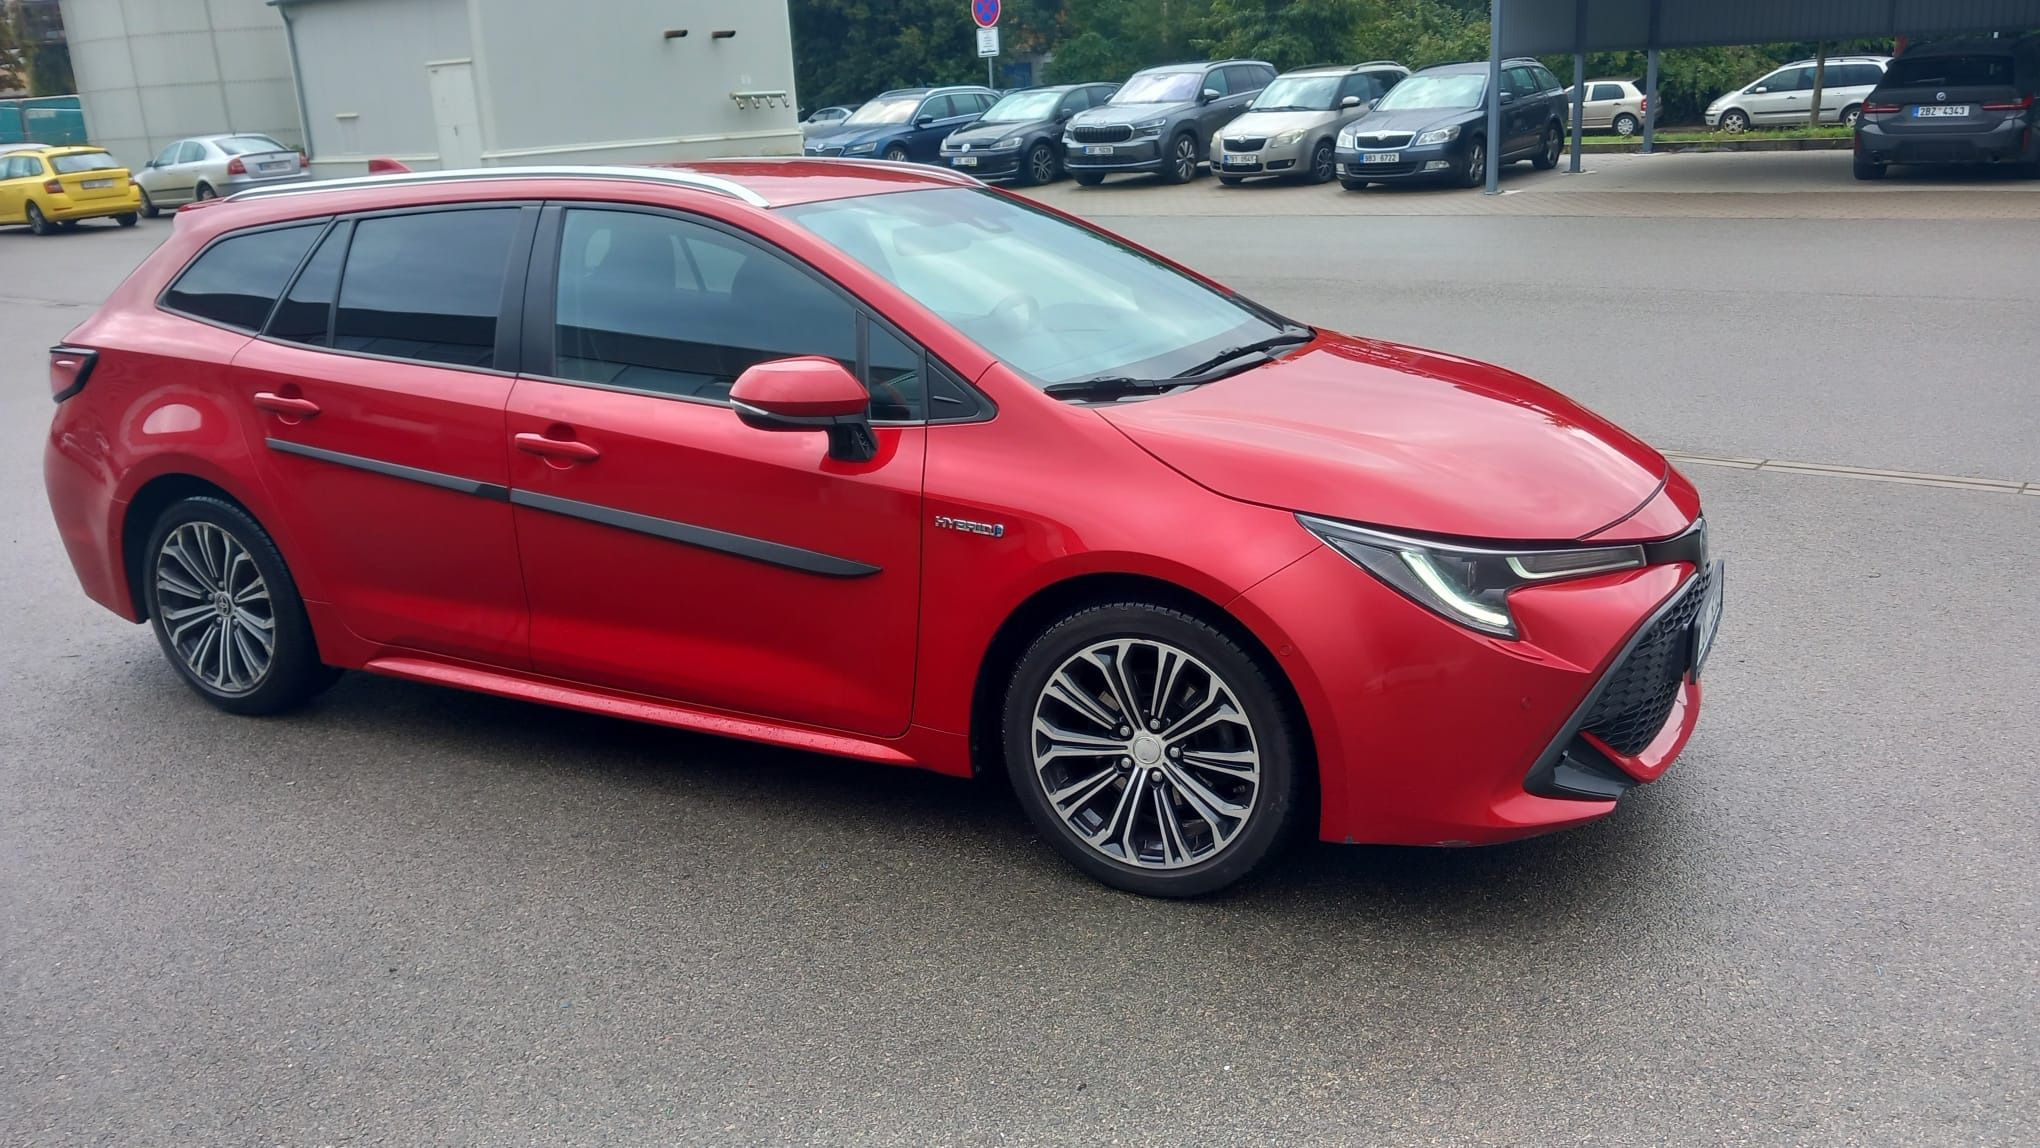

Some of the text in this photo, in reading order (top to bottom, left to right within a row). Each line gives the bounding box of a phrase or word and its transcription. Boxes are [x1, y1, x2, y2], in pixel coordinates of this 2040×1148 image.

[1920, 106, 1965, 116] 2BZ 4343
[935, 515, 994, 536] HYBRID
